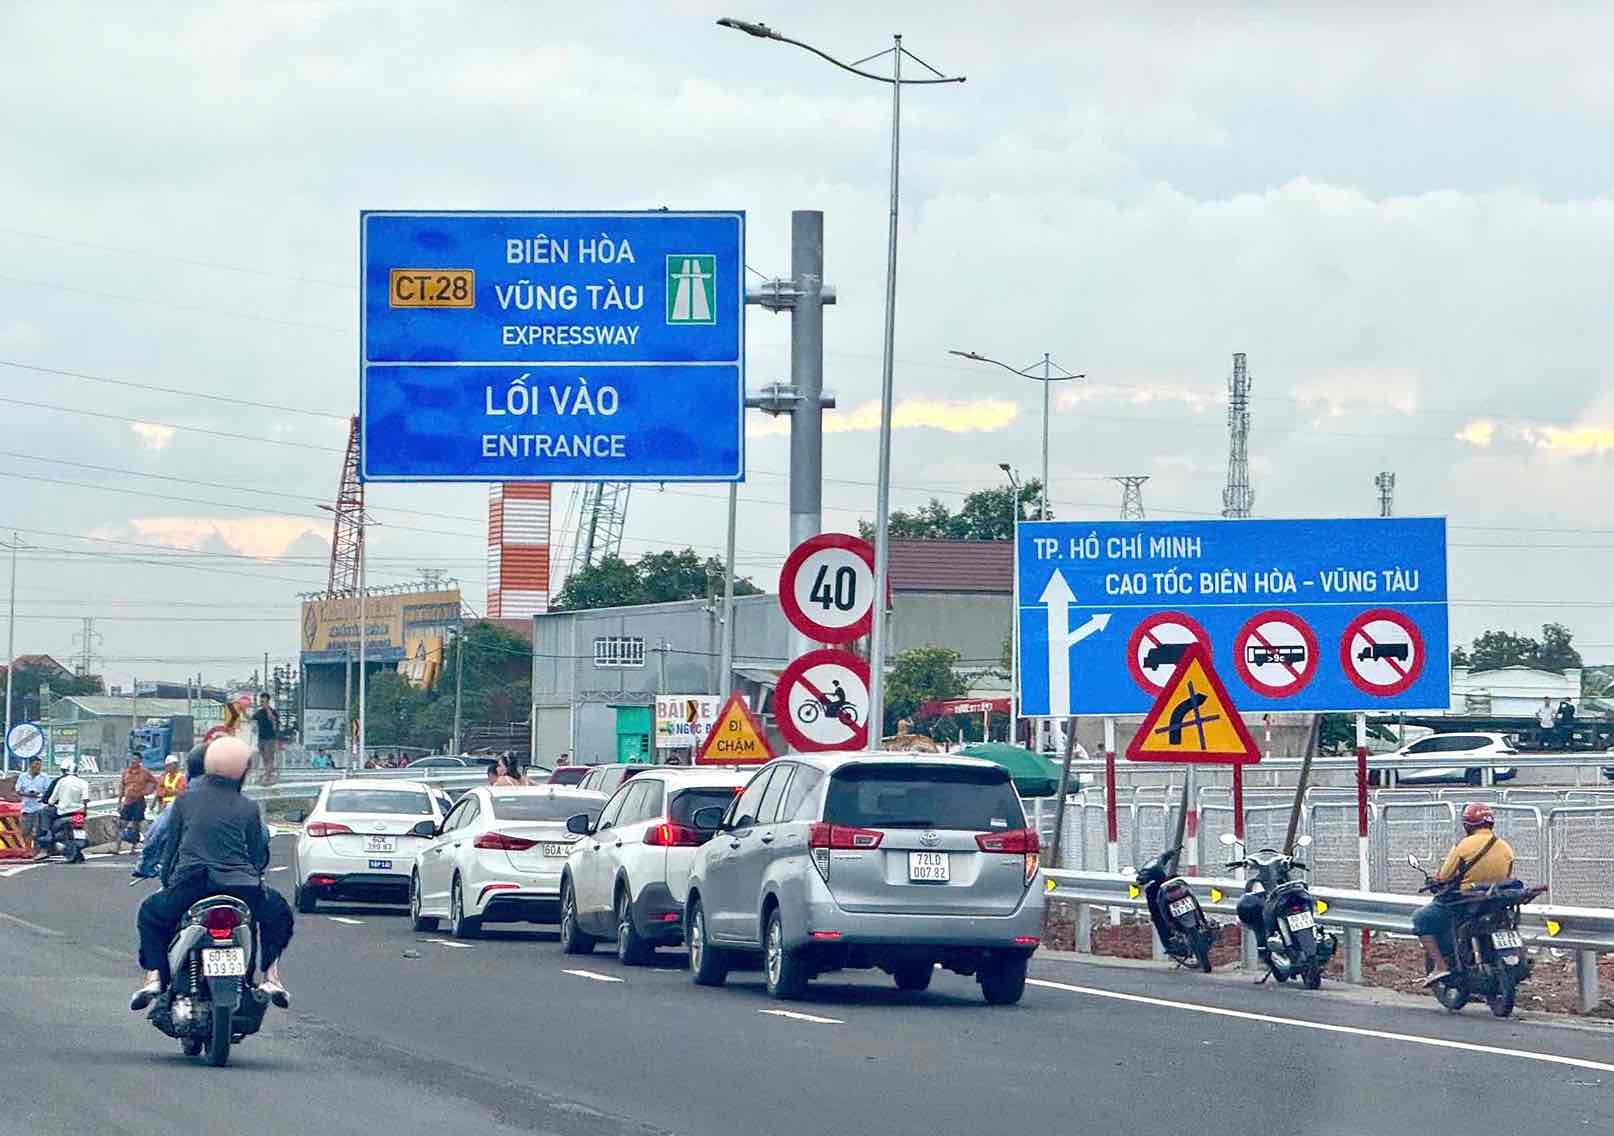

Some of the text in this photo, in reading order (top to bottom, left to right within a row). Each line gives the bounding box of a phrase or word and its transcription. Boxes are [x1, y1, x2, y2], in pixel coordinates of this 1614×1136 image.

[506, 232, 636, 264] BIÊN HÒA
[395, 276, 469, 301] CT.28
[495, 280, 644, 310] VŨNG TÀU
[502, 326, 640, 345] EXPRESSWAY
[486, 373, 618, 416] LỐI VÀO
[482, 434, 626, 457] ENTRANCE
[1033, 530, 1201, 560] TP. HỒ CHÍ MINH
[809, 565, 856, 611] 40
[1105, 574, 1148, 595] CAO
[1153, 564, 1193, 595] TỐC
[1199, 565, 1247, 594] BIÊN
[1254, 566, 1297, 593] HÒA
[1319, 566, 1376, 593] VŨNG
[1382, 563, 1420, 592] TÀU
[717, 737, 755, 754] CHẬM
